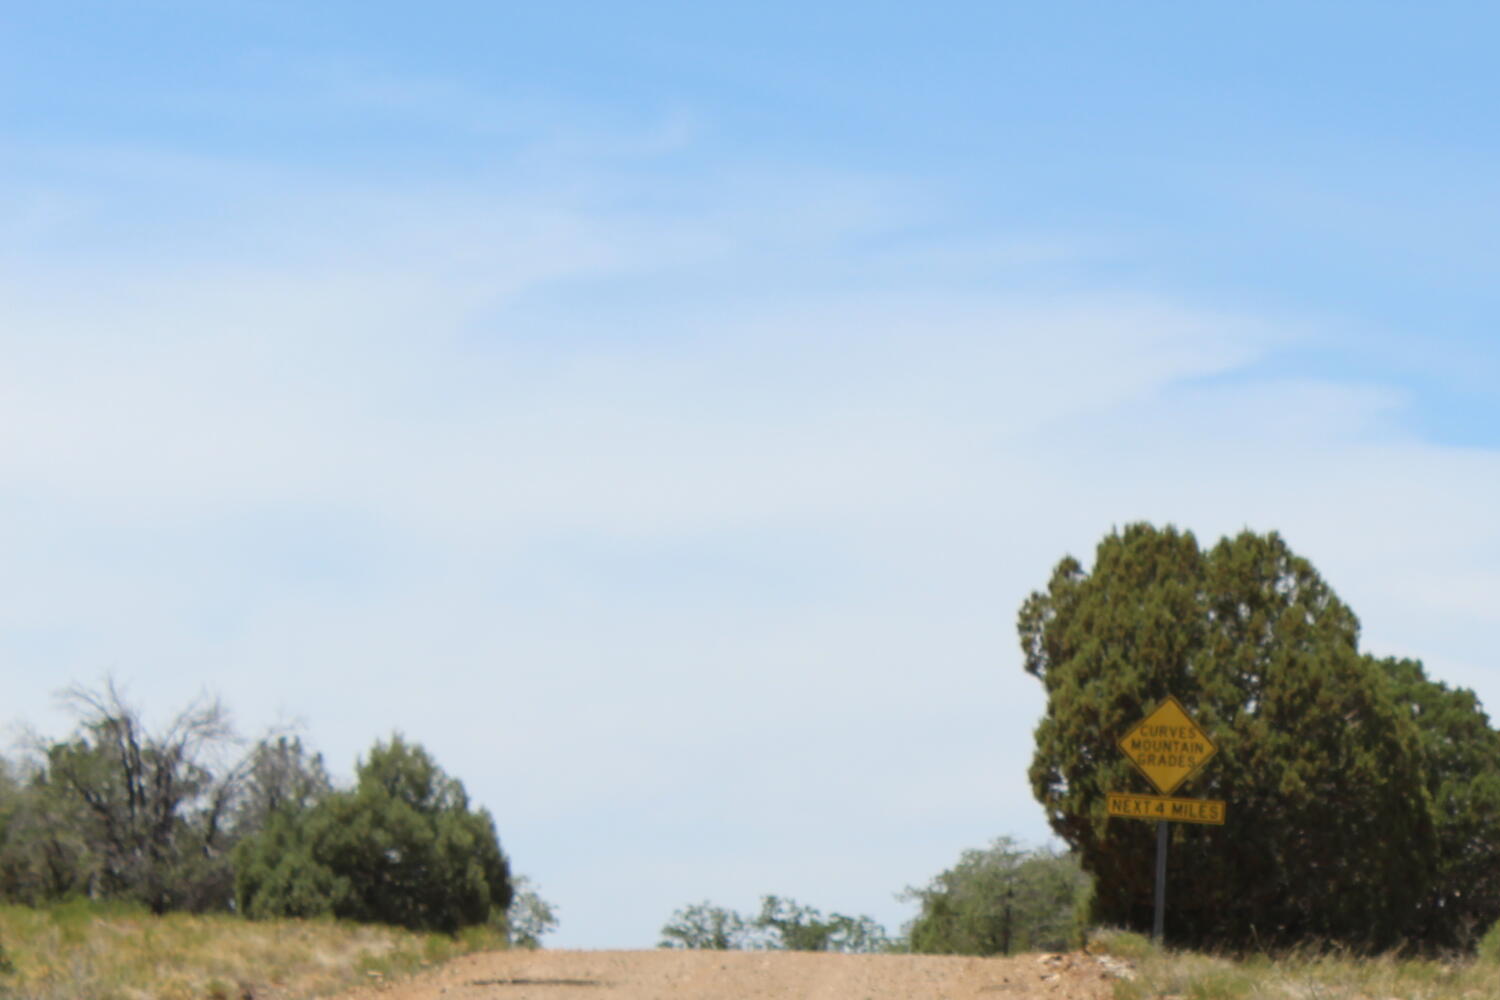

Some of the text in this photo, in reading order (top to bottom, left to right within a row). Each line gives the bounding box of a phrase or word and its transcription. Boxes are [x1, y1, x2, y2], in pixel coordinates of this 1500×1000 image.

[1140, 726, 1196, 739] CURVES
[1131, 739, 1203, 753] MOUNTAIN
[1137, 754, 1196, 768] GRADES
[1112, 799, 1218, 819] NEXT 4 MILES
